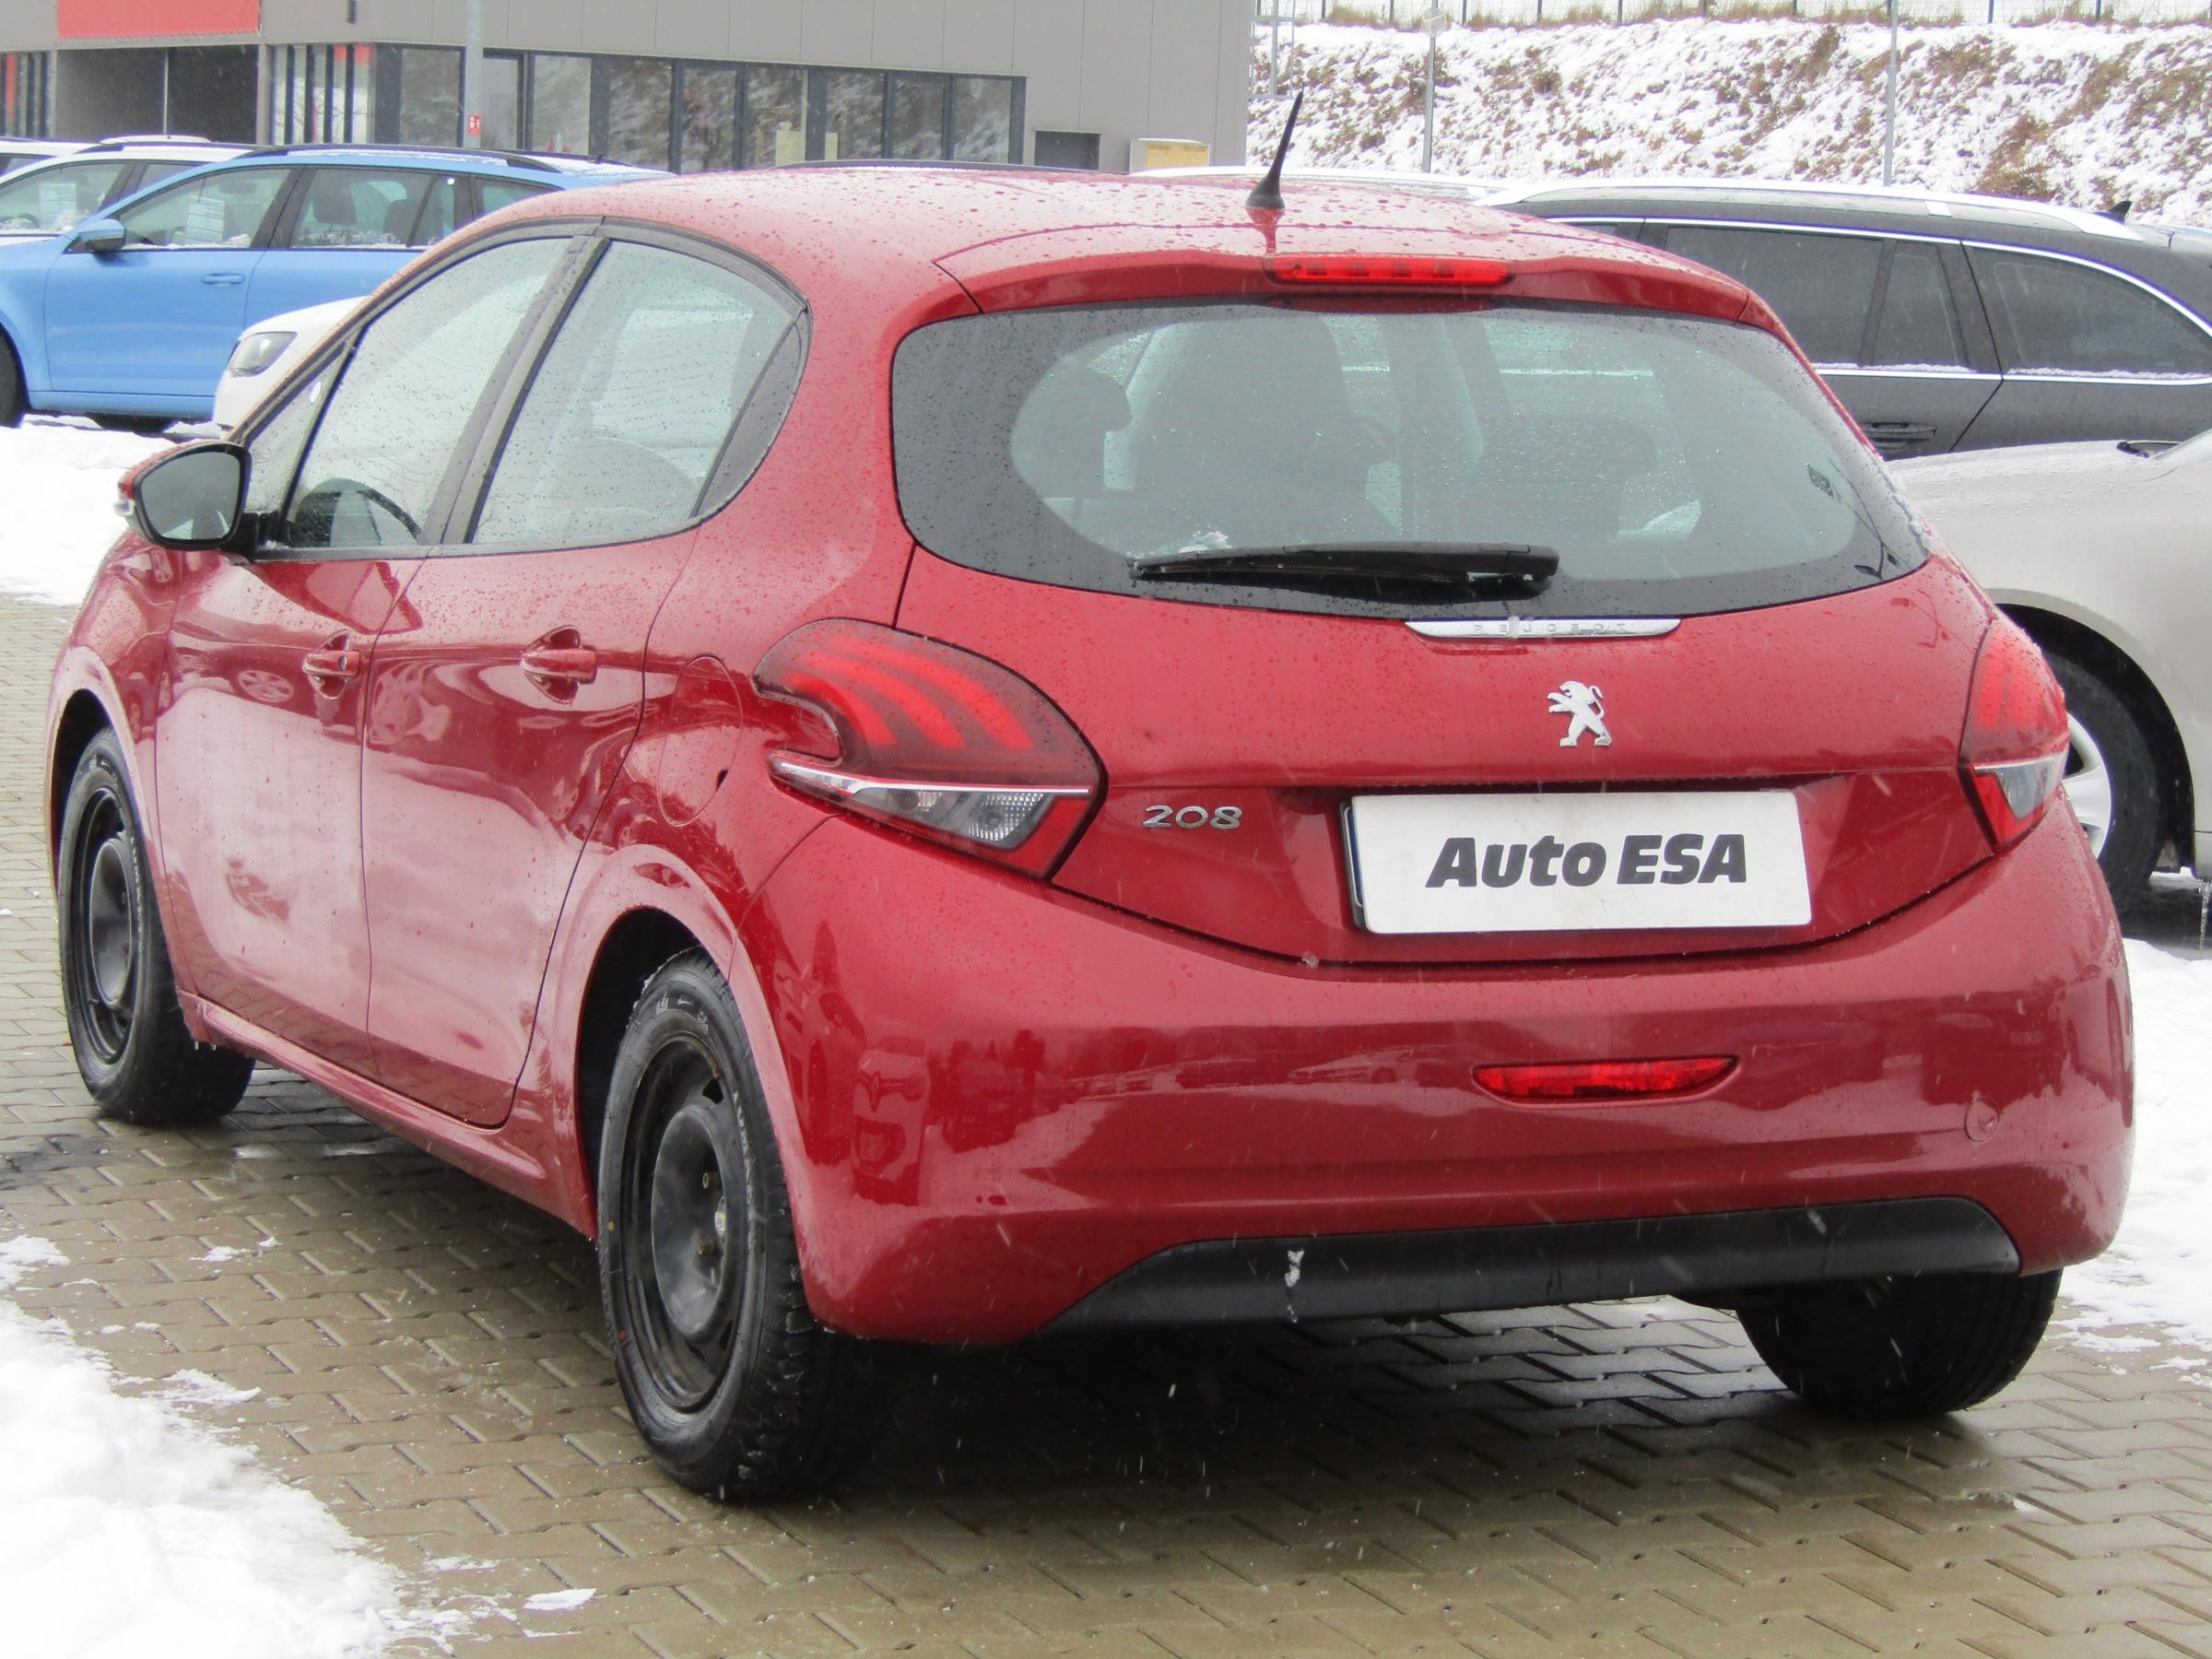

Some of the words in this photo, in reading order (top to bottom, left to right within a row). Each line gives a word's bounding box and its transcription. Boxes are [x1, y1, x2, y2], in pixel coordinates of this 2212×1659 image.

[1143, 805, 1242, 830] 208
[1425, 835, 1606, 888] Auto
[1617, 833, 1747, 885] ESA
